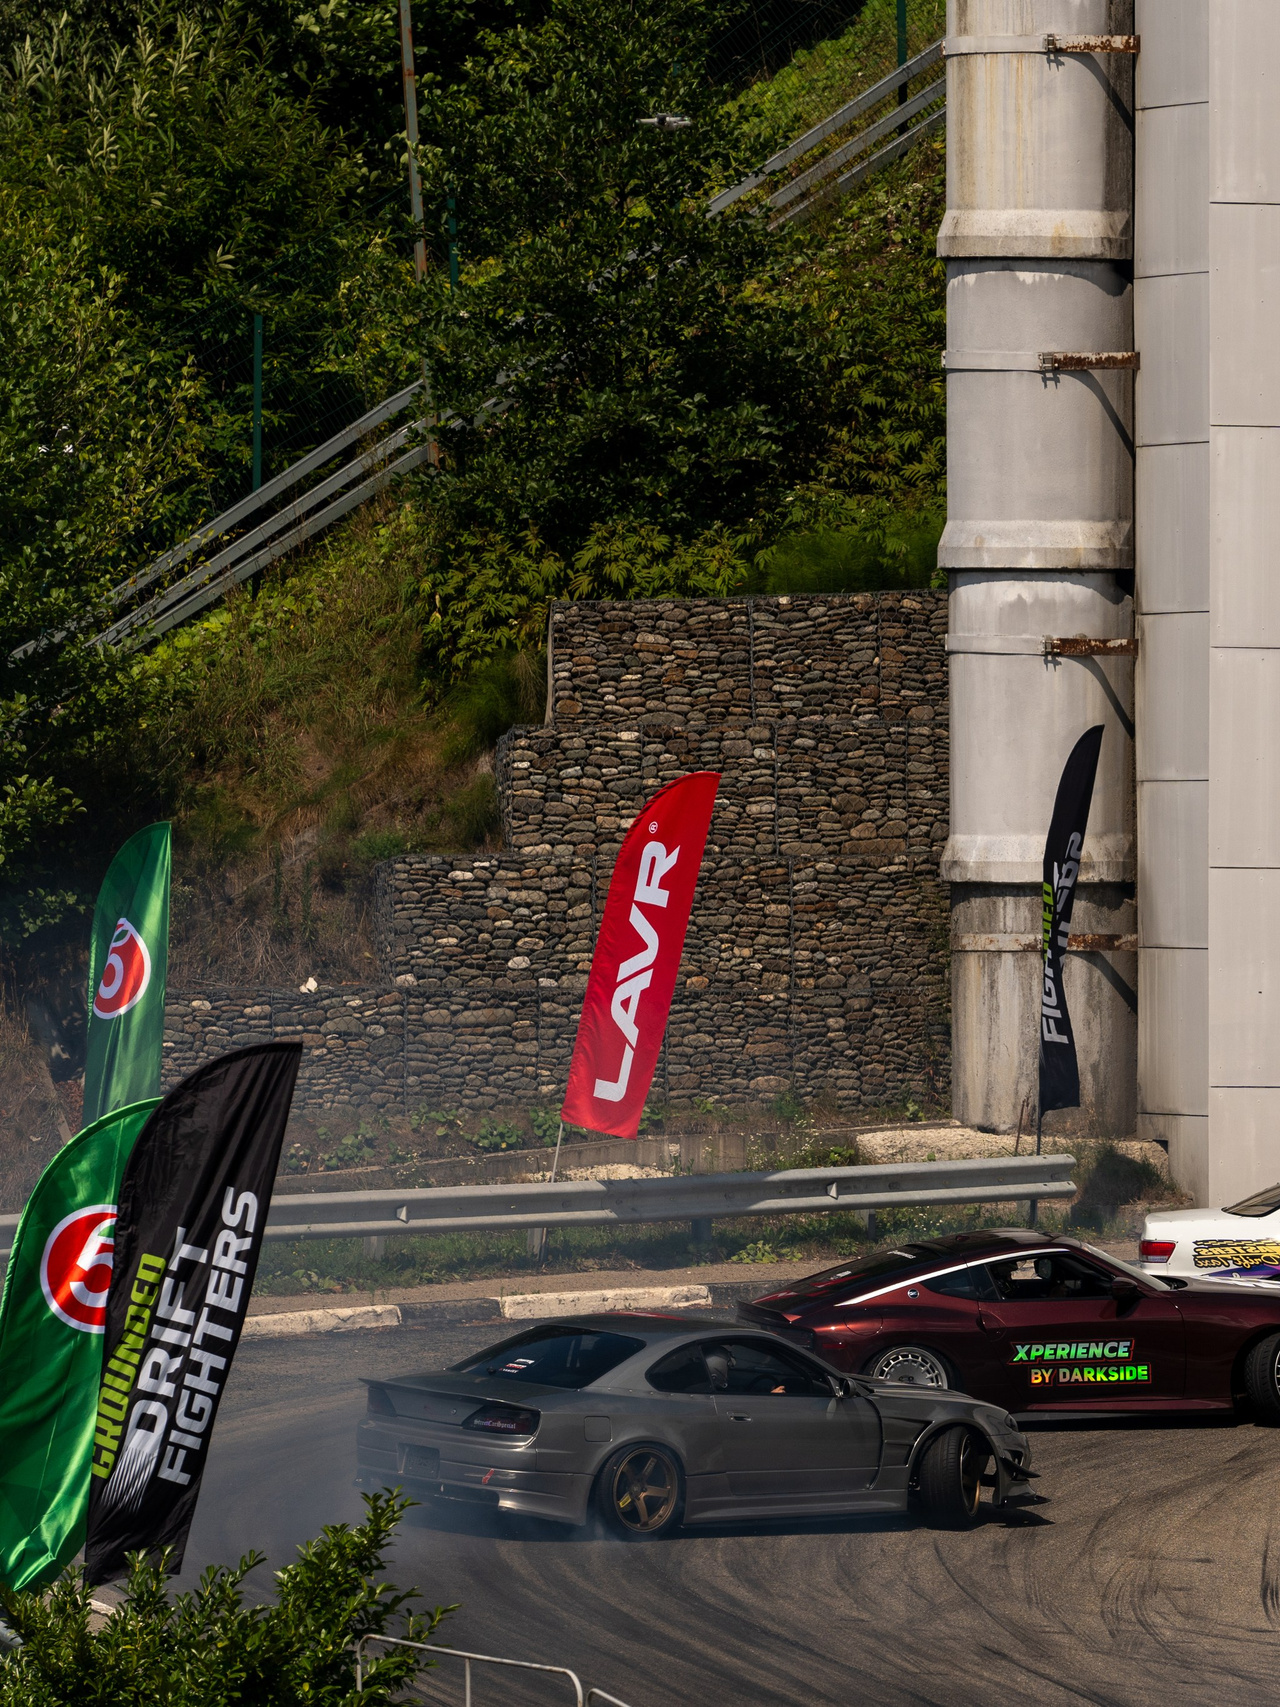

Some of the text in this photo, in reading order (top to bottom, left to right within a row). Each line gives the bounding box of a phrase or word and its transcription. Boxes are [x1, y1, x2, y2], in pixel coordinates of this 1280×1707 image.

[92, 1253, 166, 1479] GROUNDED
[108, 1226, 208, 1490] DRIFT
[157, 1187, 257, 1485] FIGHTERS
[1013, 1341, 1130, 1361] XPERIENCE
[1031, 1365, 1148, 1383] BY DARKSIDE
